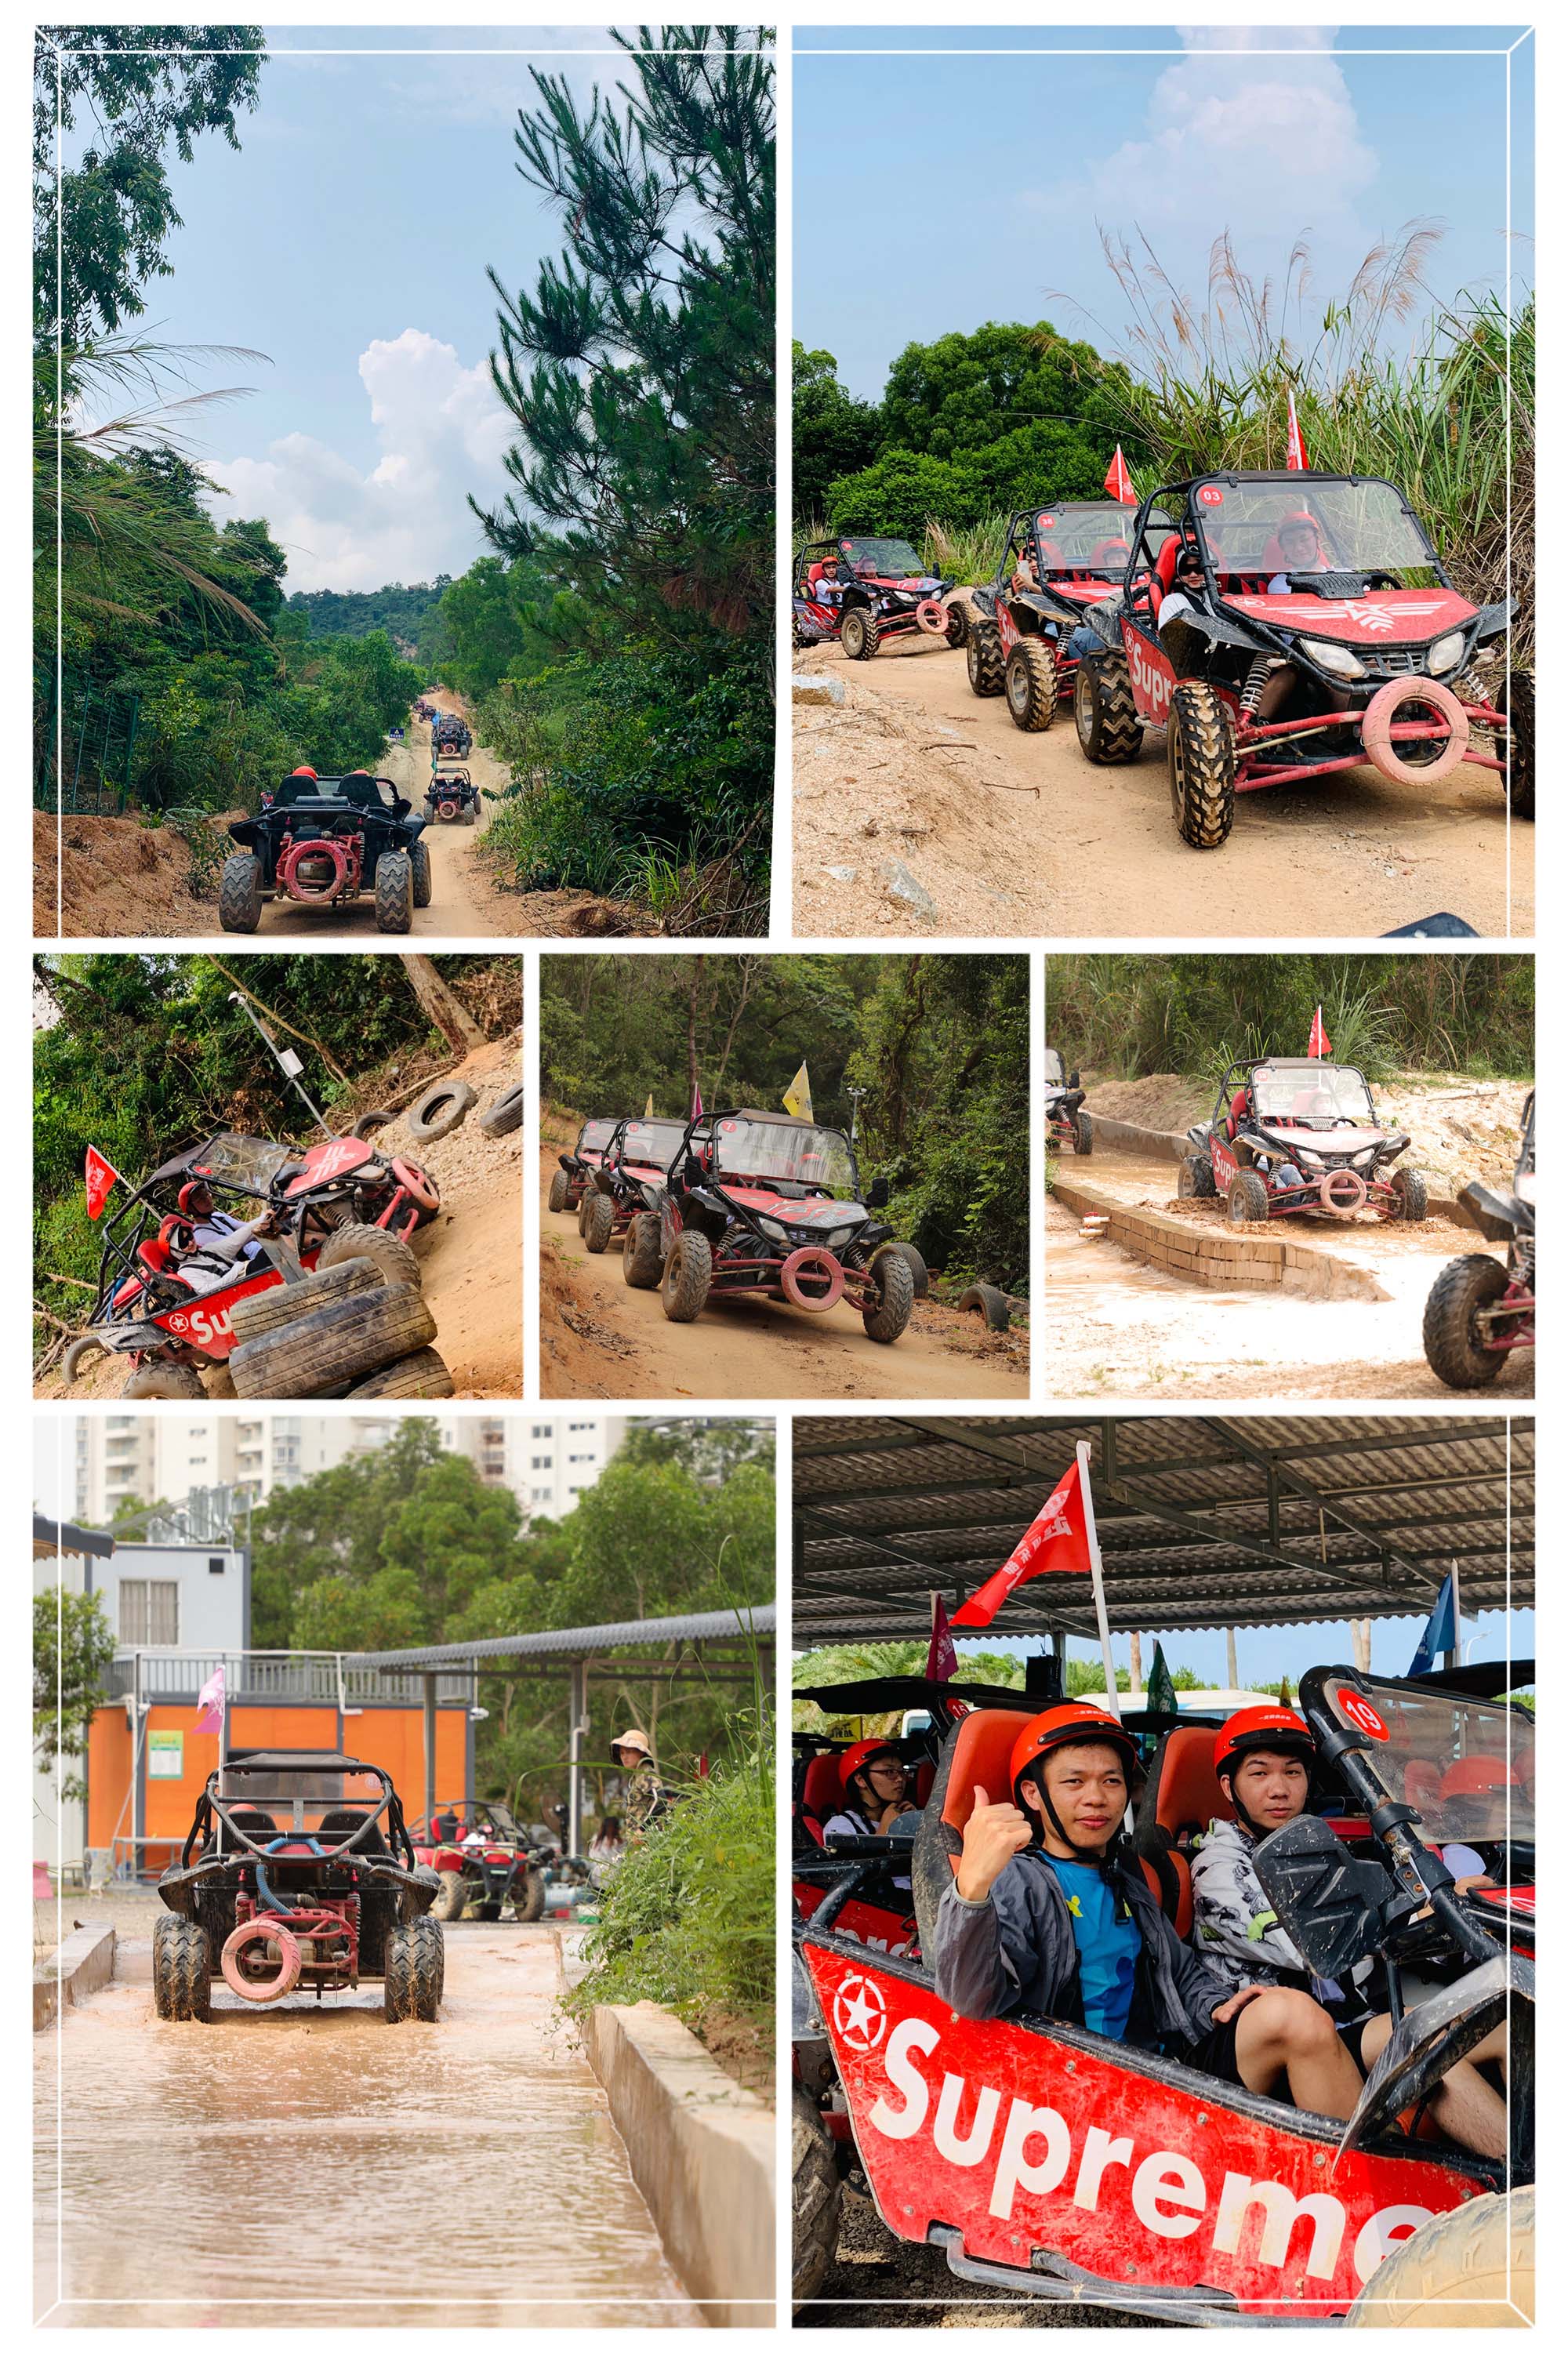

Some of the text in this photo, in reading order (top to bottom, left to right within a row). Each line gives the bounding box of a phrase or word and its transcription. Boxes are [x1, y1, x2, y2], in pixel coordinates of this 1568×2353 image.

[1203, 491, 1221, 500] 03
[1132, 643, 1179, 712] Supr
[725, 1122, 733, 1131] 7
[953, 1705, 968, 1716] 15
[1346, 1701, 1381, 1730] 19
